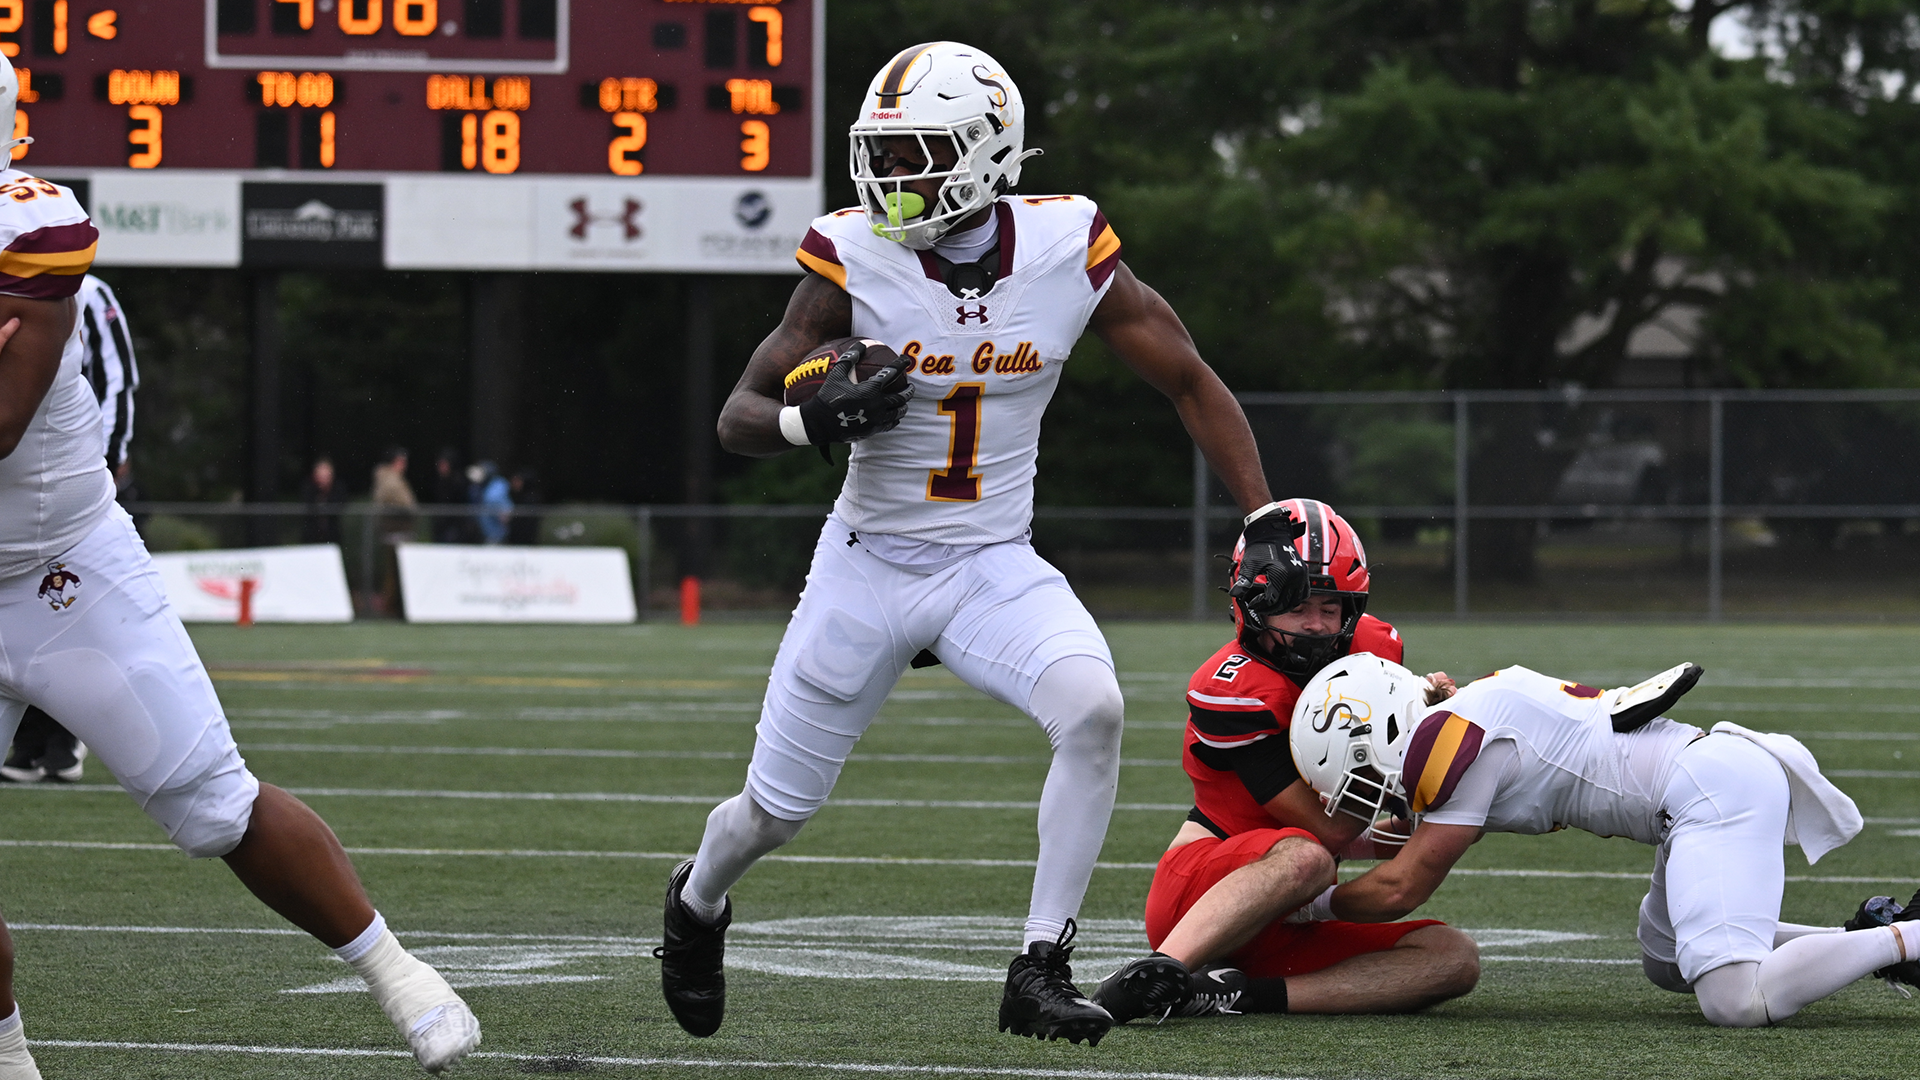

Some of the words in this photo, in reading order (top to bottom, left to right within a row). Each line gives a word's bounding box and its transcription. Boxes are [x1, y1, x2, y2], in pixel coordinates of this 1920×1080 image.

[747, 6, 782, 67] 7
[128, 105, 162, 169] 3
[320, 112, 335, 167] 1
[461, 110, 520, 174] 18
[608, 112, 647, 176] 2
[740, 120, 770, 171] 3
[901, 340, 954, 375] Sea
[971, 341, 1042, 375] Gulls
[925, 382, 986, 502] 1
[1211, 654, 1252, 683] 2
